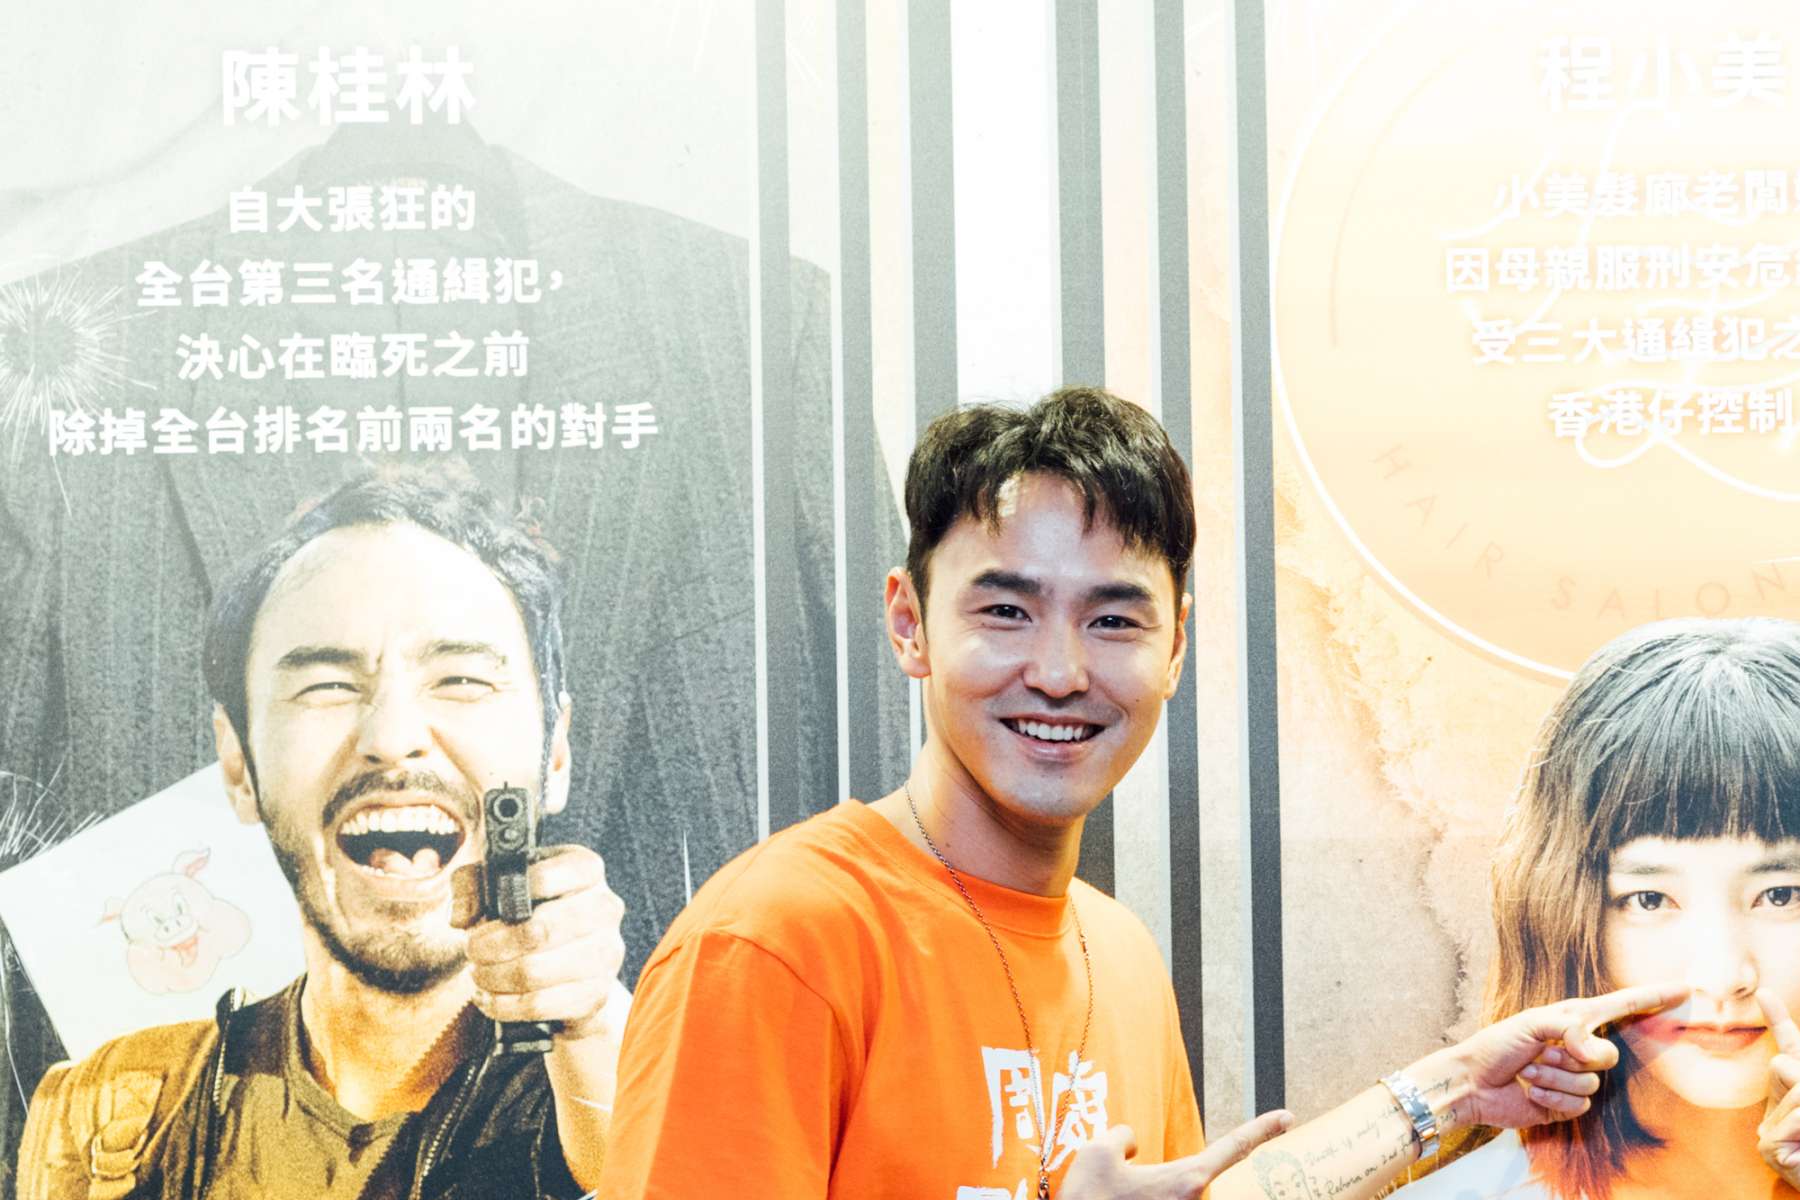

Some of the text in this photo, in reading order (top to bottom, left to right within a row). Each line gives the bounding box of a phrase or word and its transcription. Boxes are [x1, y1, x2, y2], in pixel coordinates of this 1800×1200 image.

[221, 46, 478, 127] 陳桂林
[1539, 34, 1788, 113] 程小美
[228, 184, 477, 233] 自大張狂的
[176, 330, 530, 382] 決心在臨死之前
[47, 402, 659, 457] 除掉全台排名前兩名的對手
[1547, 390, 1797, 440] 香港仔控制
[1371, 443, 1789, 620] HAIR SALON
